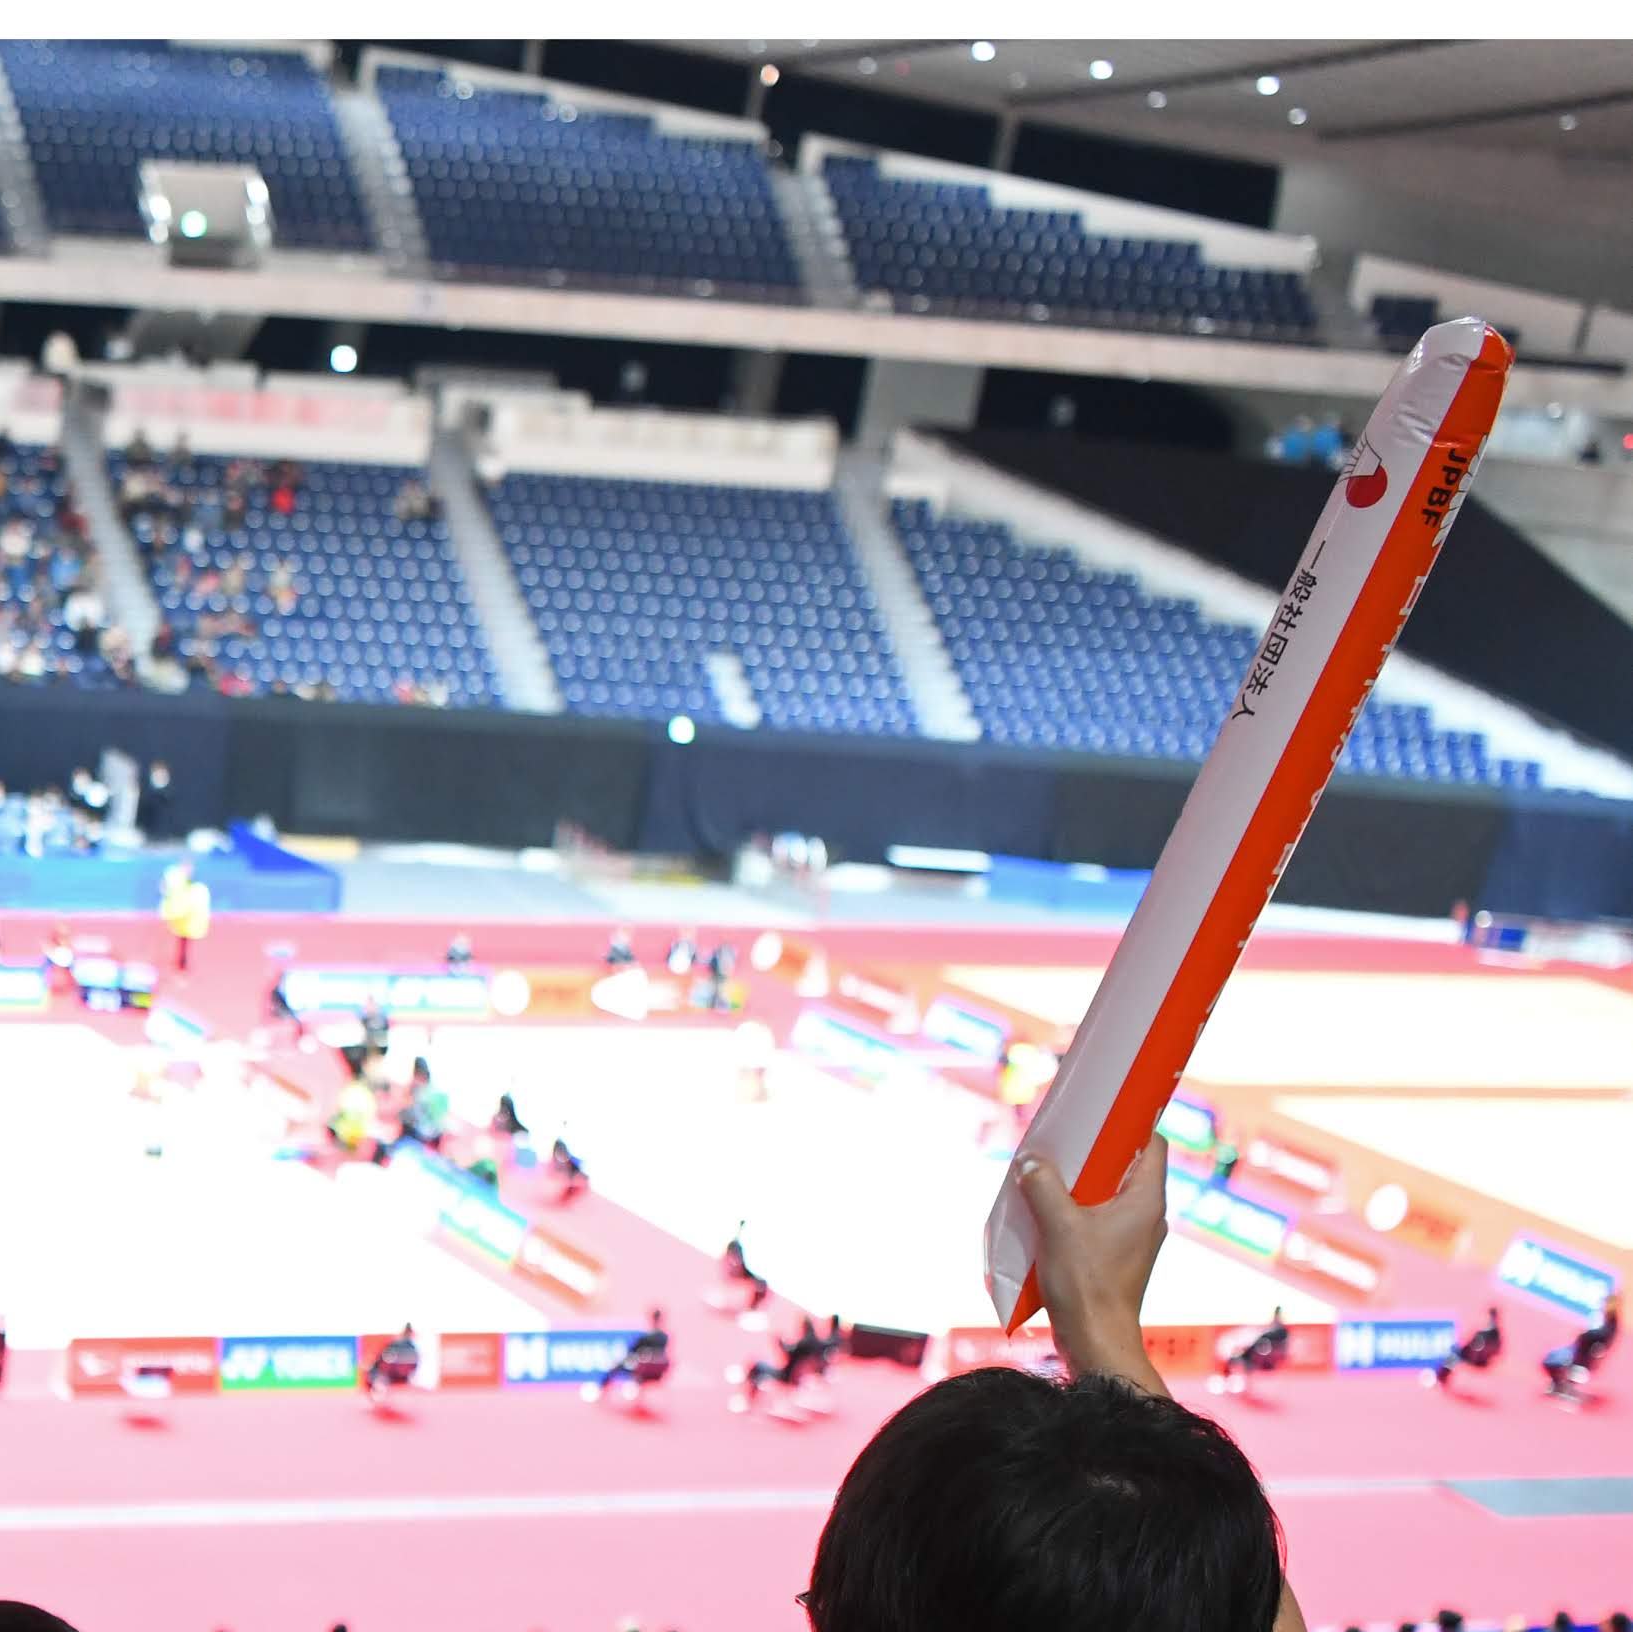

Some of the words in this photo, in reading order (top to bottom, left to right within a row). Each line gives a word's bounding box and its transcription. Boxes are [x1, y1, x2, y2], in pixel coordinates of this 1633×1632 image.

[1420, 448, 1468, 528] JPBF
[1231, 539, 1327, 721] 一般社団法人
